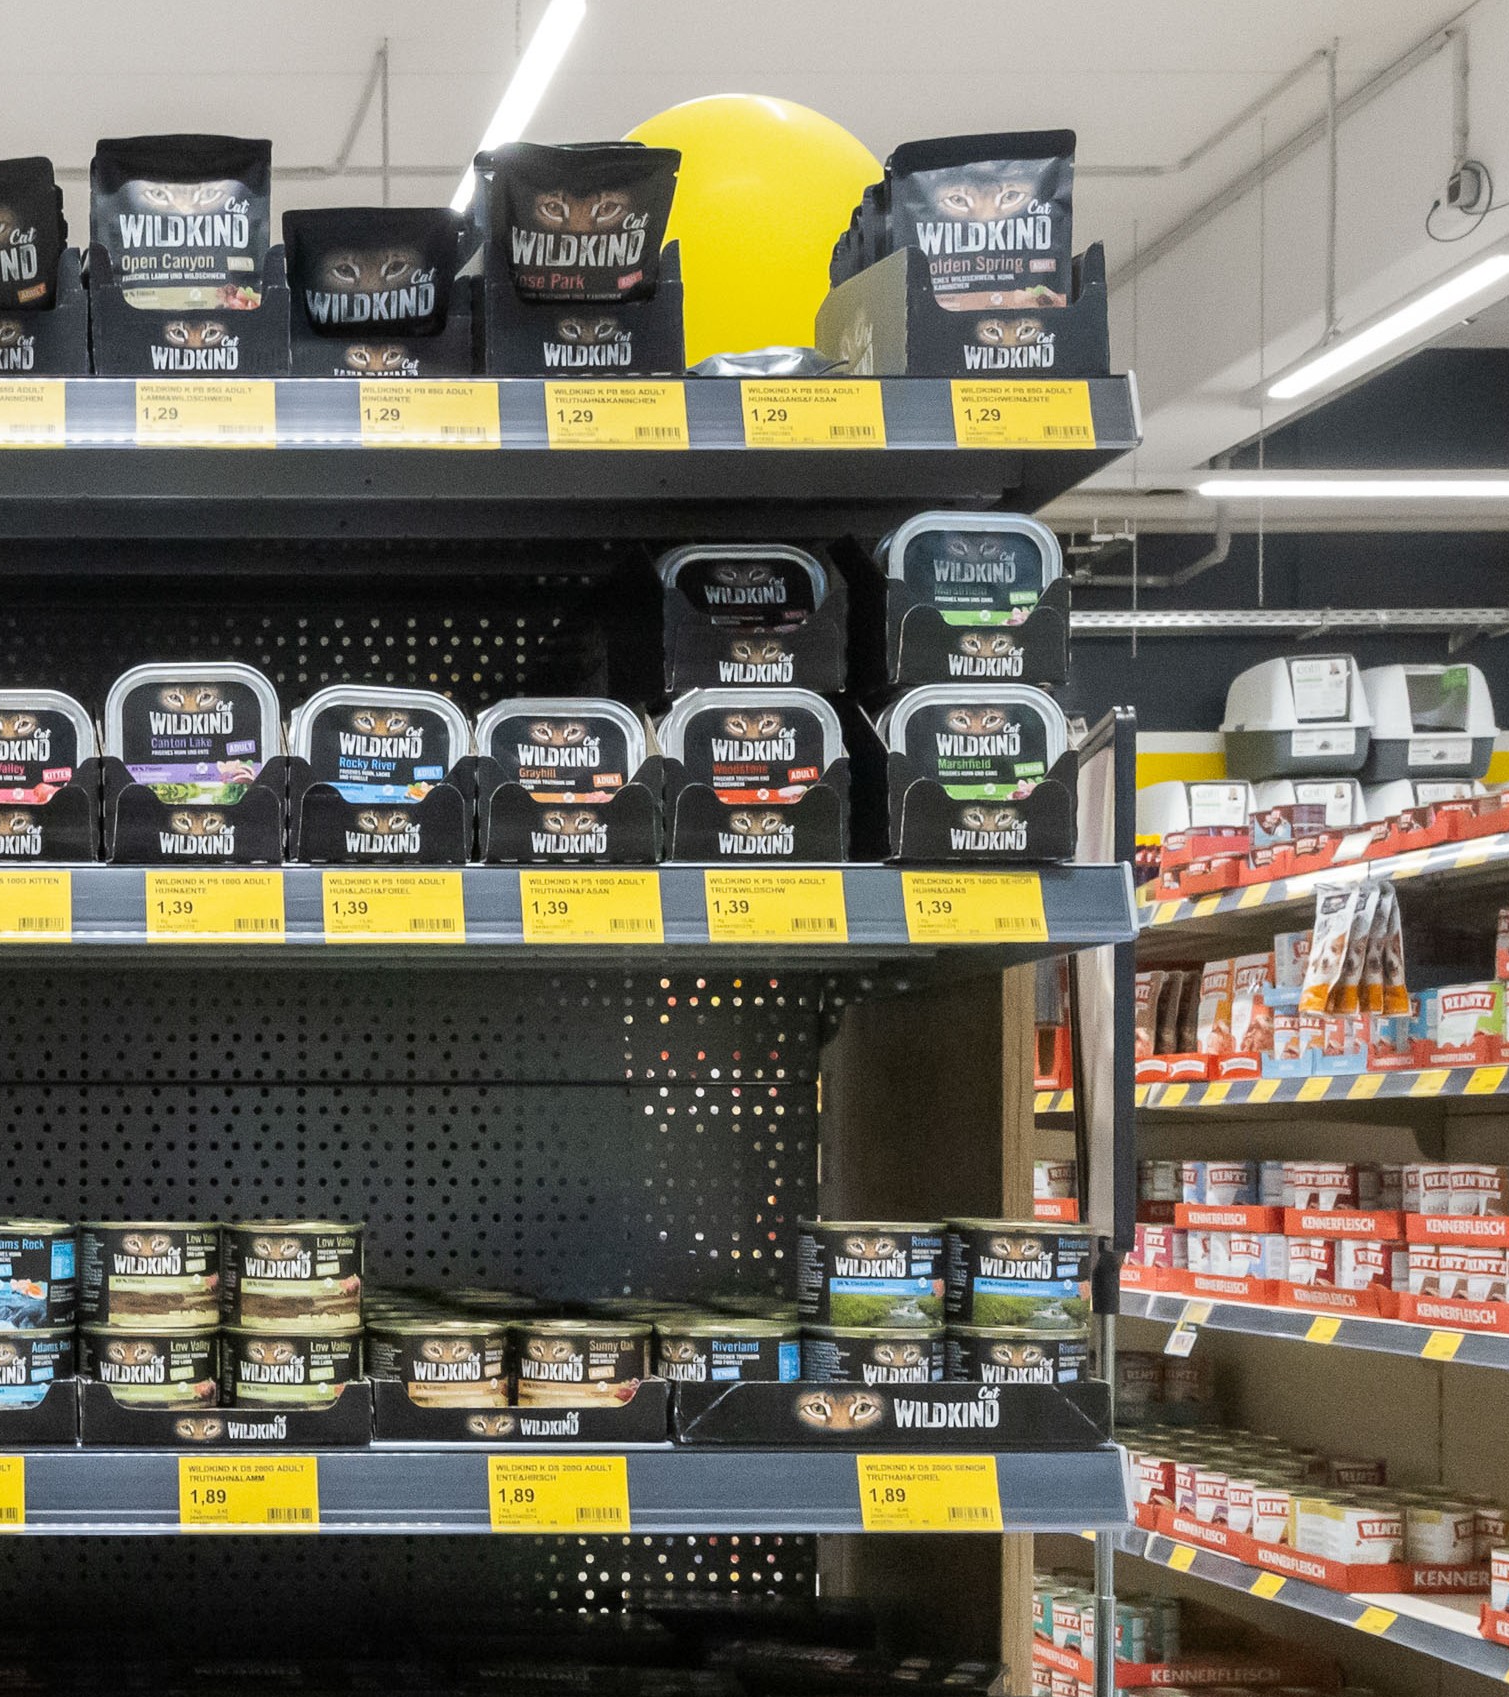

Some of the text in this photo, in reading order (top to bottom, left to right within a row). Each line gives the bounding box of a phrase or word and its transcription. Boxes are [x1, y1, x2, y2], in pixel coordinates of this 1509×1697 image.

[120, 214, 248, 249] WILDKIND
[122, 252, 214, 272] Open Canyon
[149, 711, 233, 736] WILDKIND
[339, 757, 396, 771] Rocky River
[938, 758, 990, 771] Marshfield
[44, 768, 72, 782] KITTEN
[1441, 991, 1496, 1011] RINTI
[23, 1239, 45, 1251] Rock
[712, 1340, 759, 1353] Riverland
[894, 1394, 1000, 1430] WILDKIND
[498, 1488, 535, 1505] 1,89
